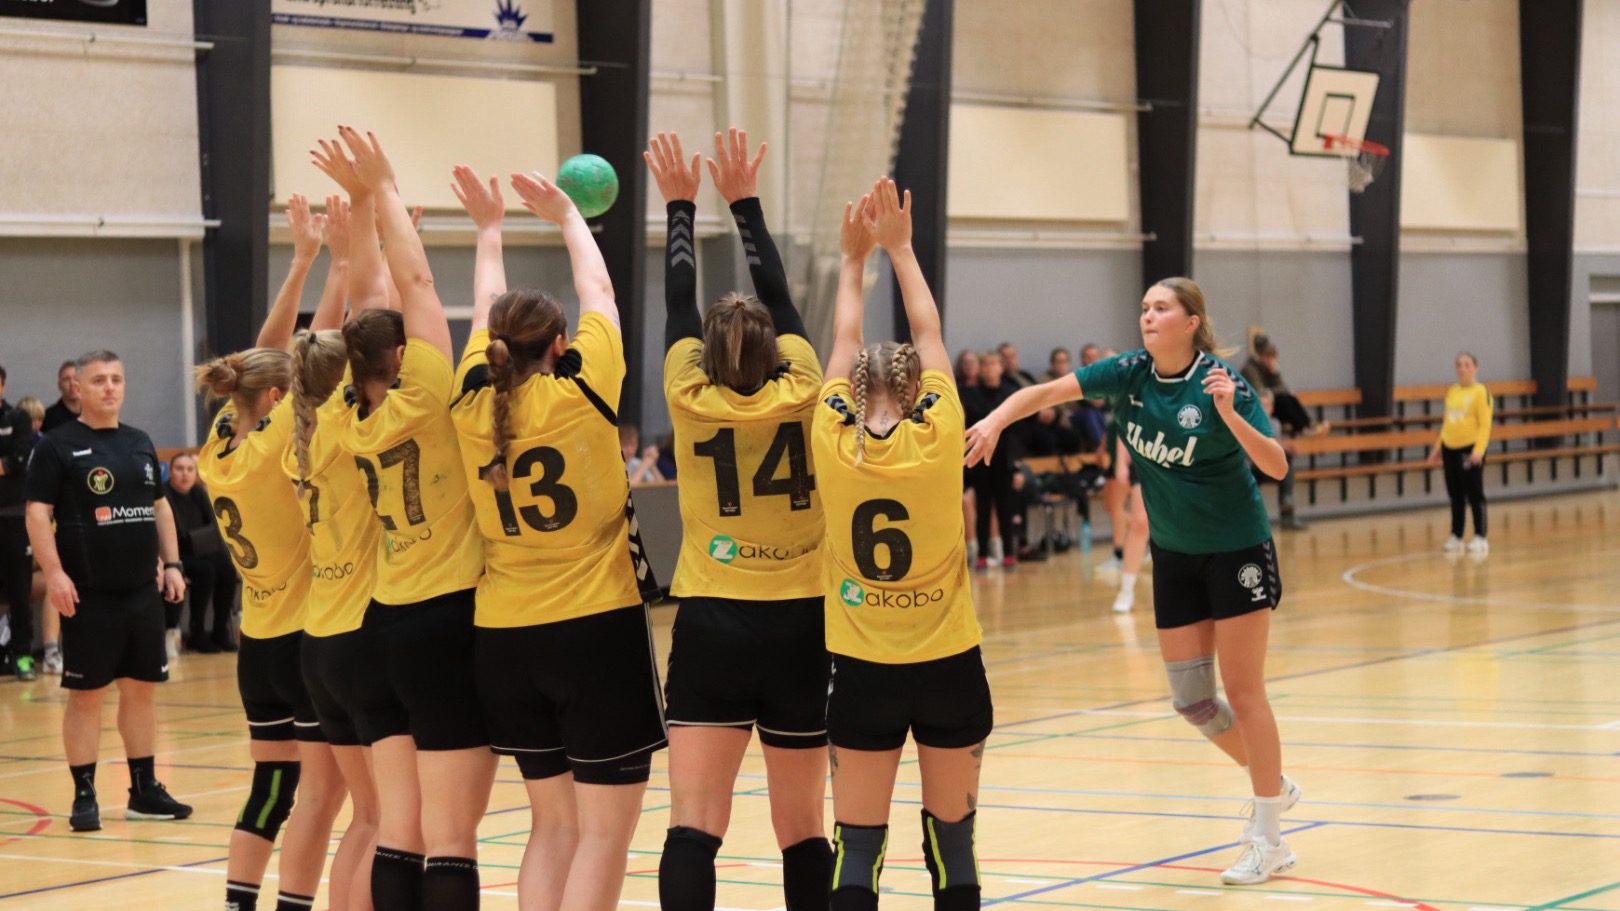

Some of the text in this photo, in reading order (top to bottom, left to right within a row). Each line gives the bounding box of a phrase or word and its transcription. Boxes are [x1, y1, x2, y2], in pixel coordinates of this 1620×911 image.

[478, 446, 578, 536] 13
[694, 421, 816, 517] 14
[213, 496, 259, 569] 3
[851, 498, 913, 582] 6
[842, 580, 944, 609] Zakobo
